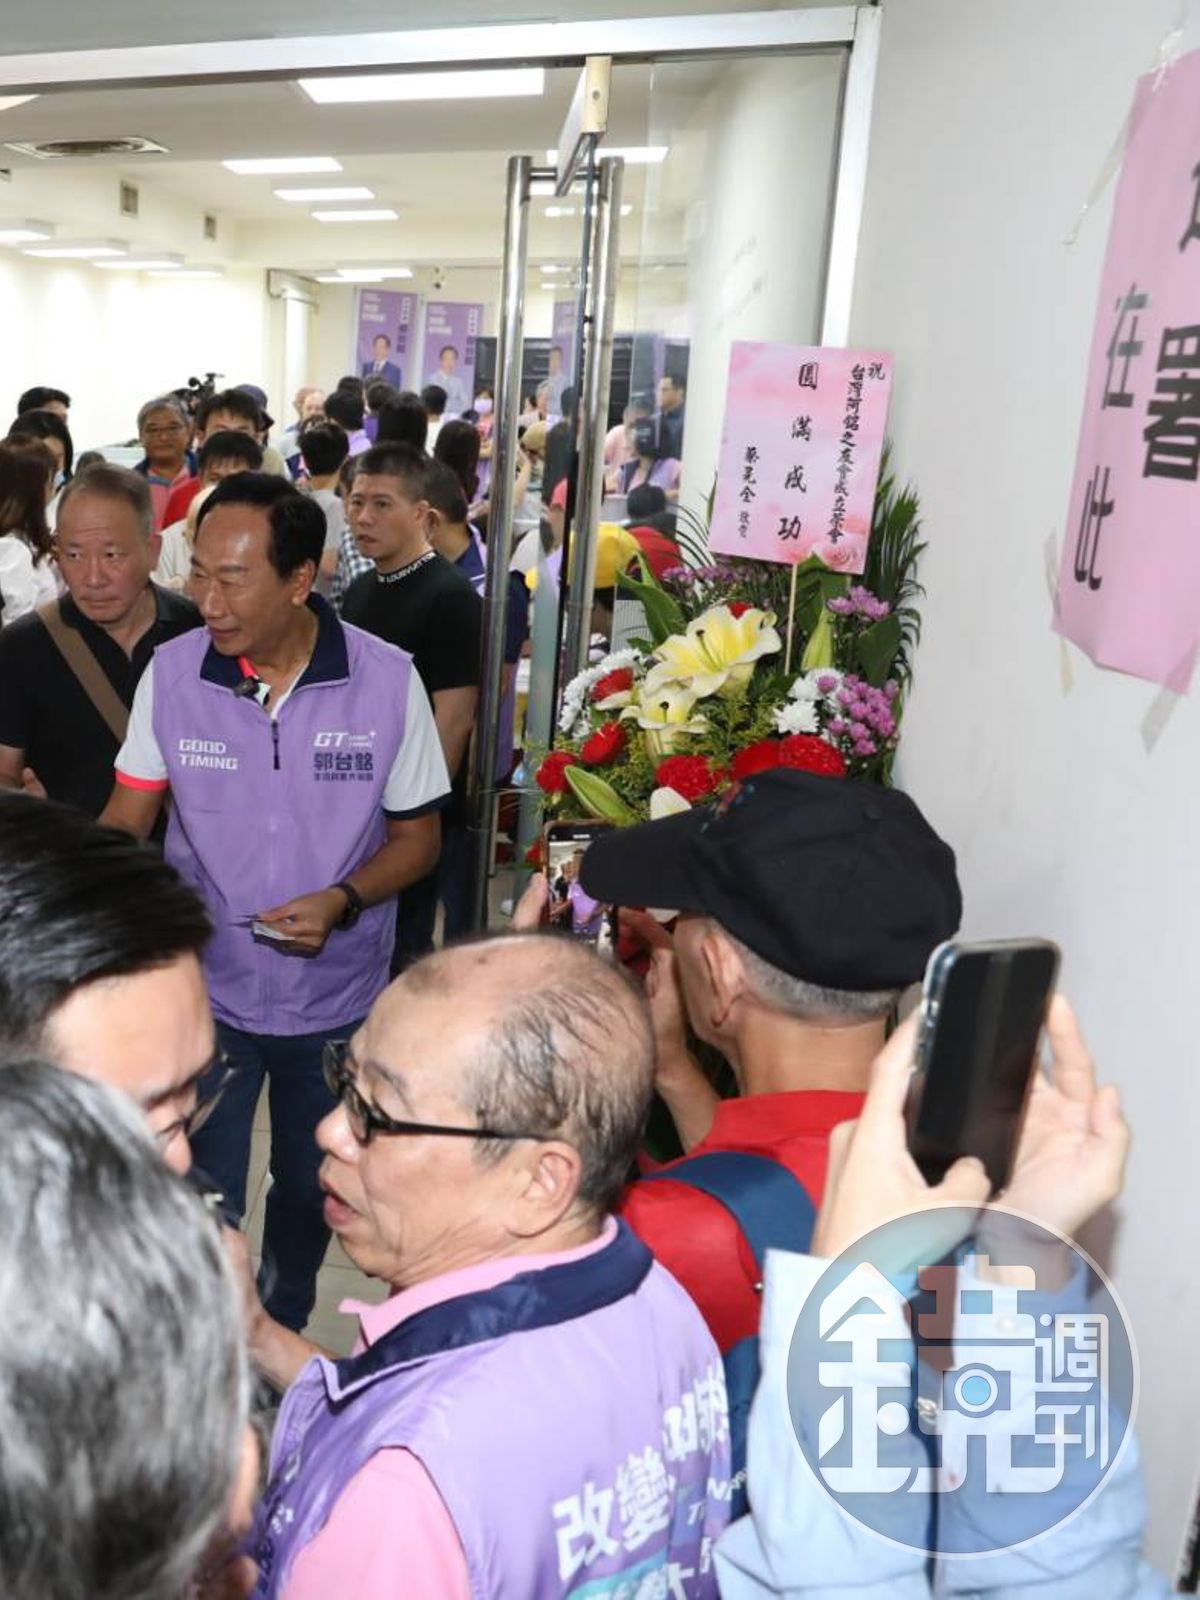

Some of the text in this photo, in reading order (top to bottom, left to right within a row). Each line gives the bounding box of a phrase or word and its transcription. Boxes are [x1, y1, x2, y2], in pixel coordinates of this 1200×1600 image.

[777, 361, 819, 541] 圓滿成功
[1074, 282, 1150, 592] 在此
[179, 739, 227, 754] GOOD
